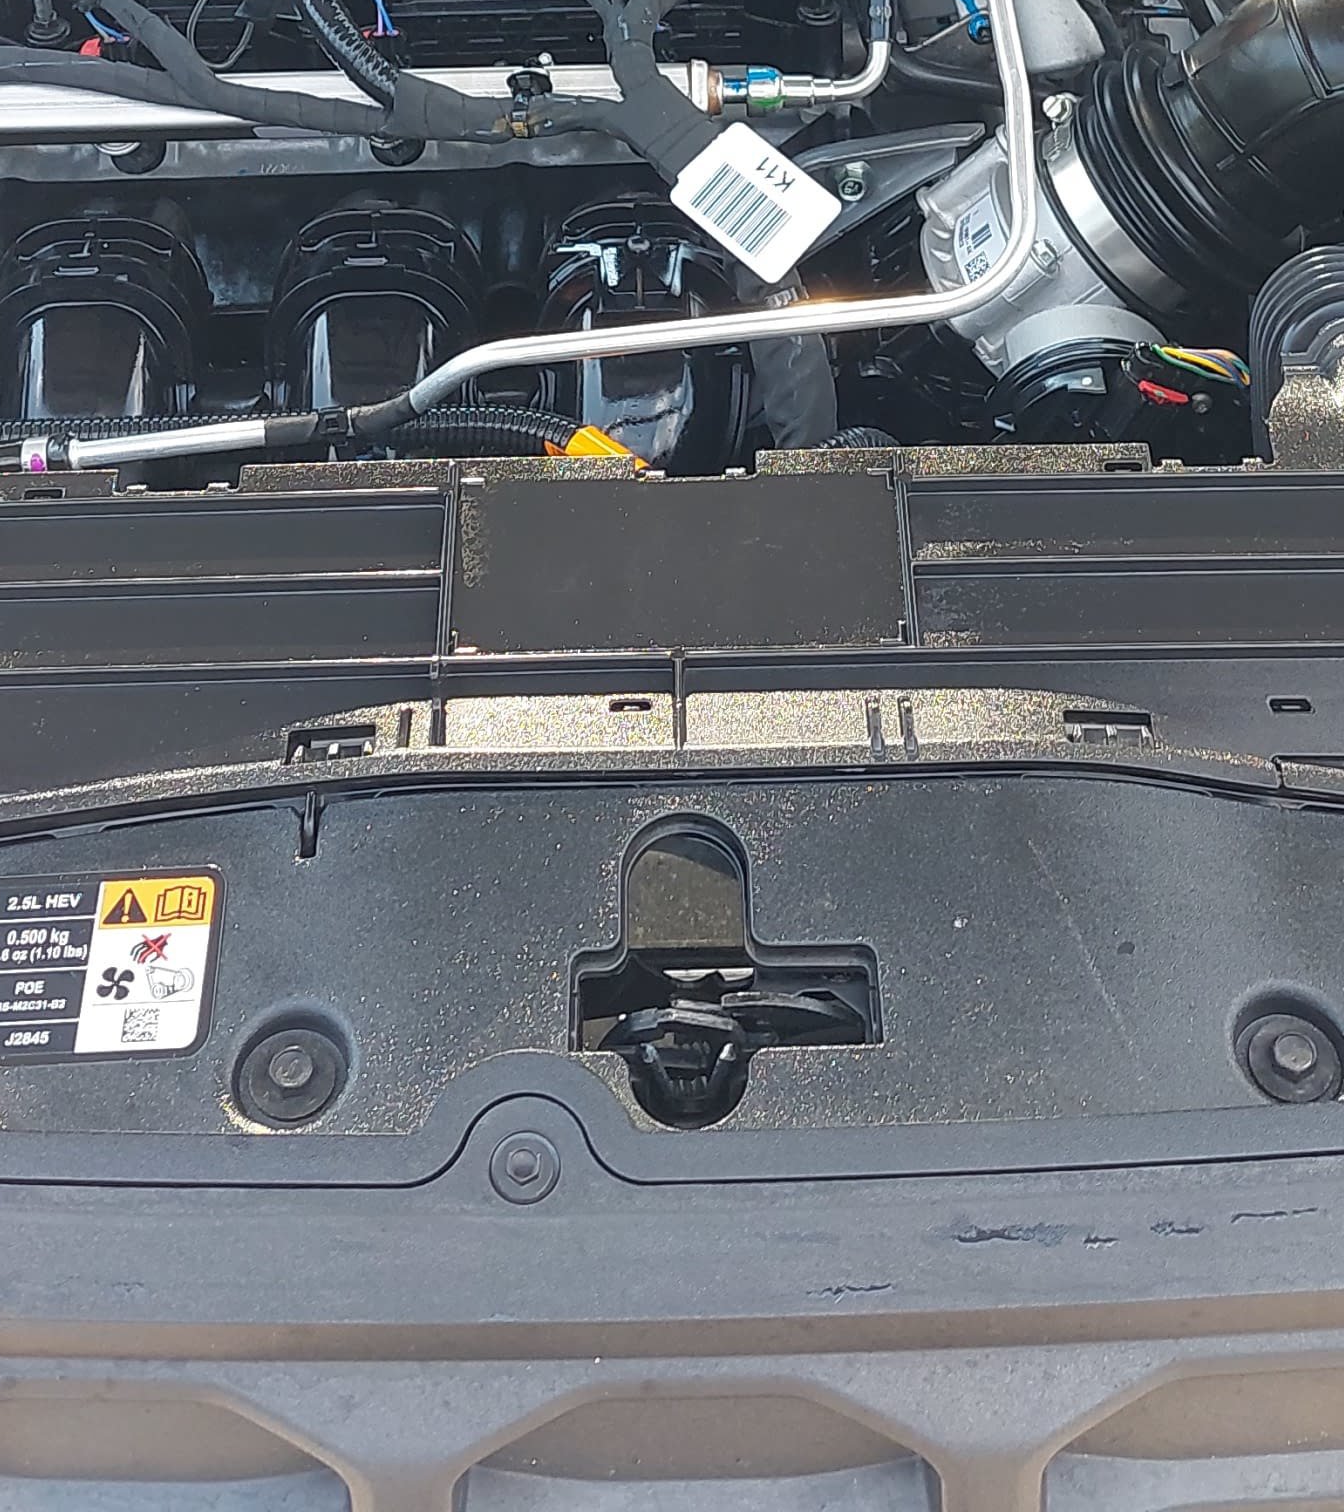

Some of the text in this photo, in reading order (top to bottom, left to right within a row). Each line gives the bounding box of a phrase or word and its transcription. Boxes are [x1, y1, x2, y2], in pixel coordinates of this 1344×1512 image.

[756, 157, 796, 193] K11
[7, 892, 82, 911] 2.5L HEV
[6, 927, 69, 946] 0.500 kg
[12, 950, 29, 962] oz
[14, 980, 45, 995] POE
[4, 1030, 50, 1047] J2845
